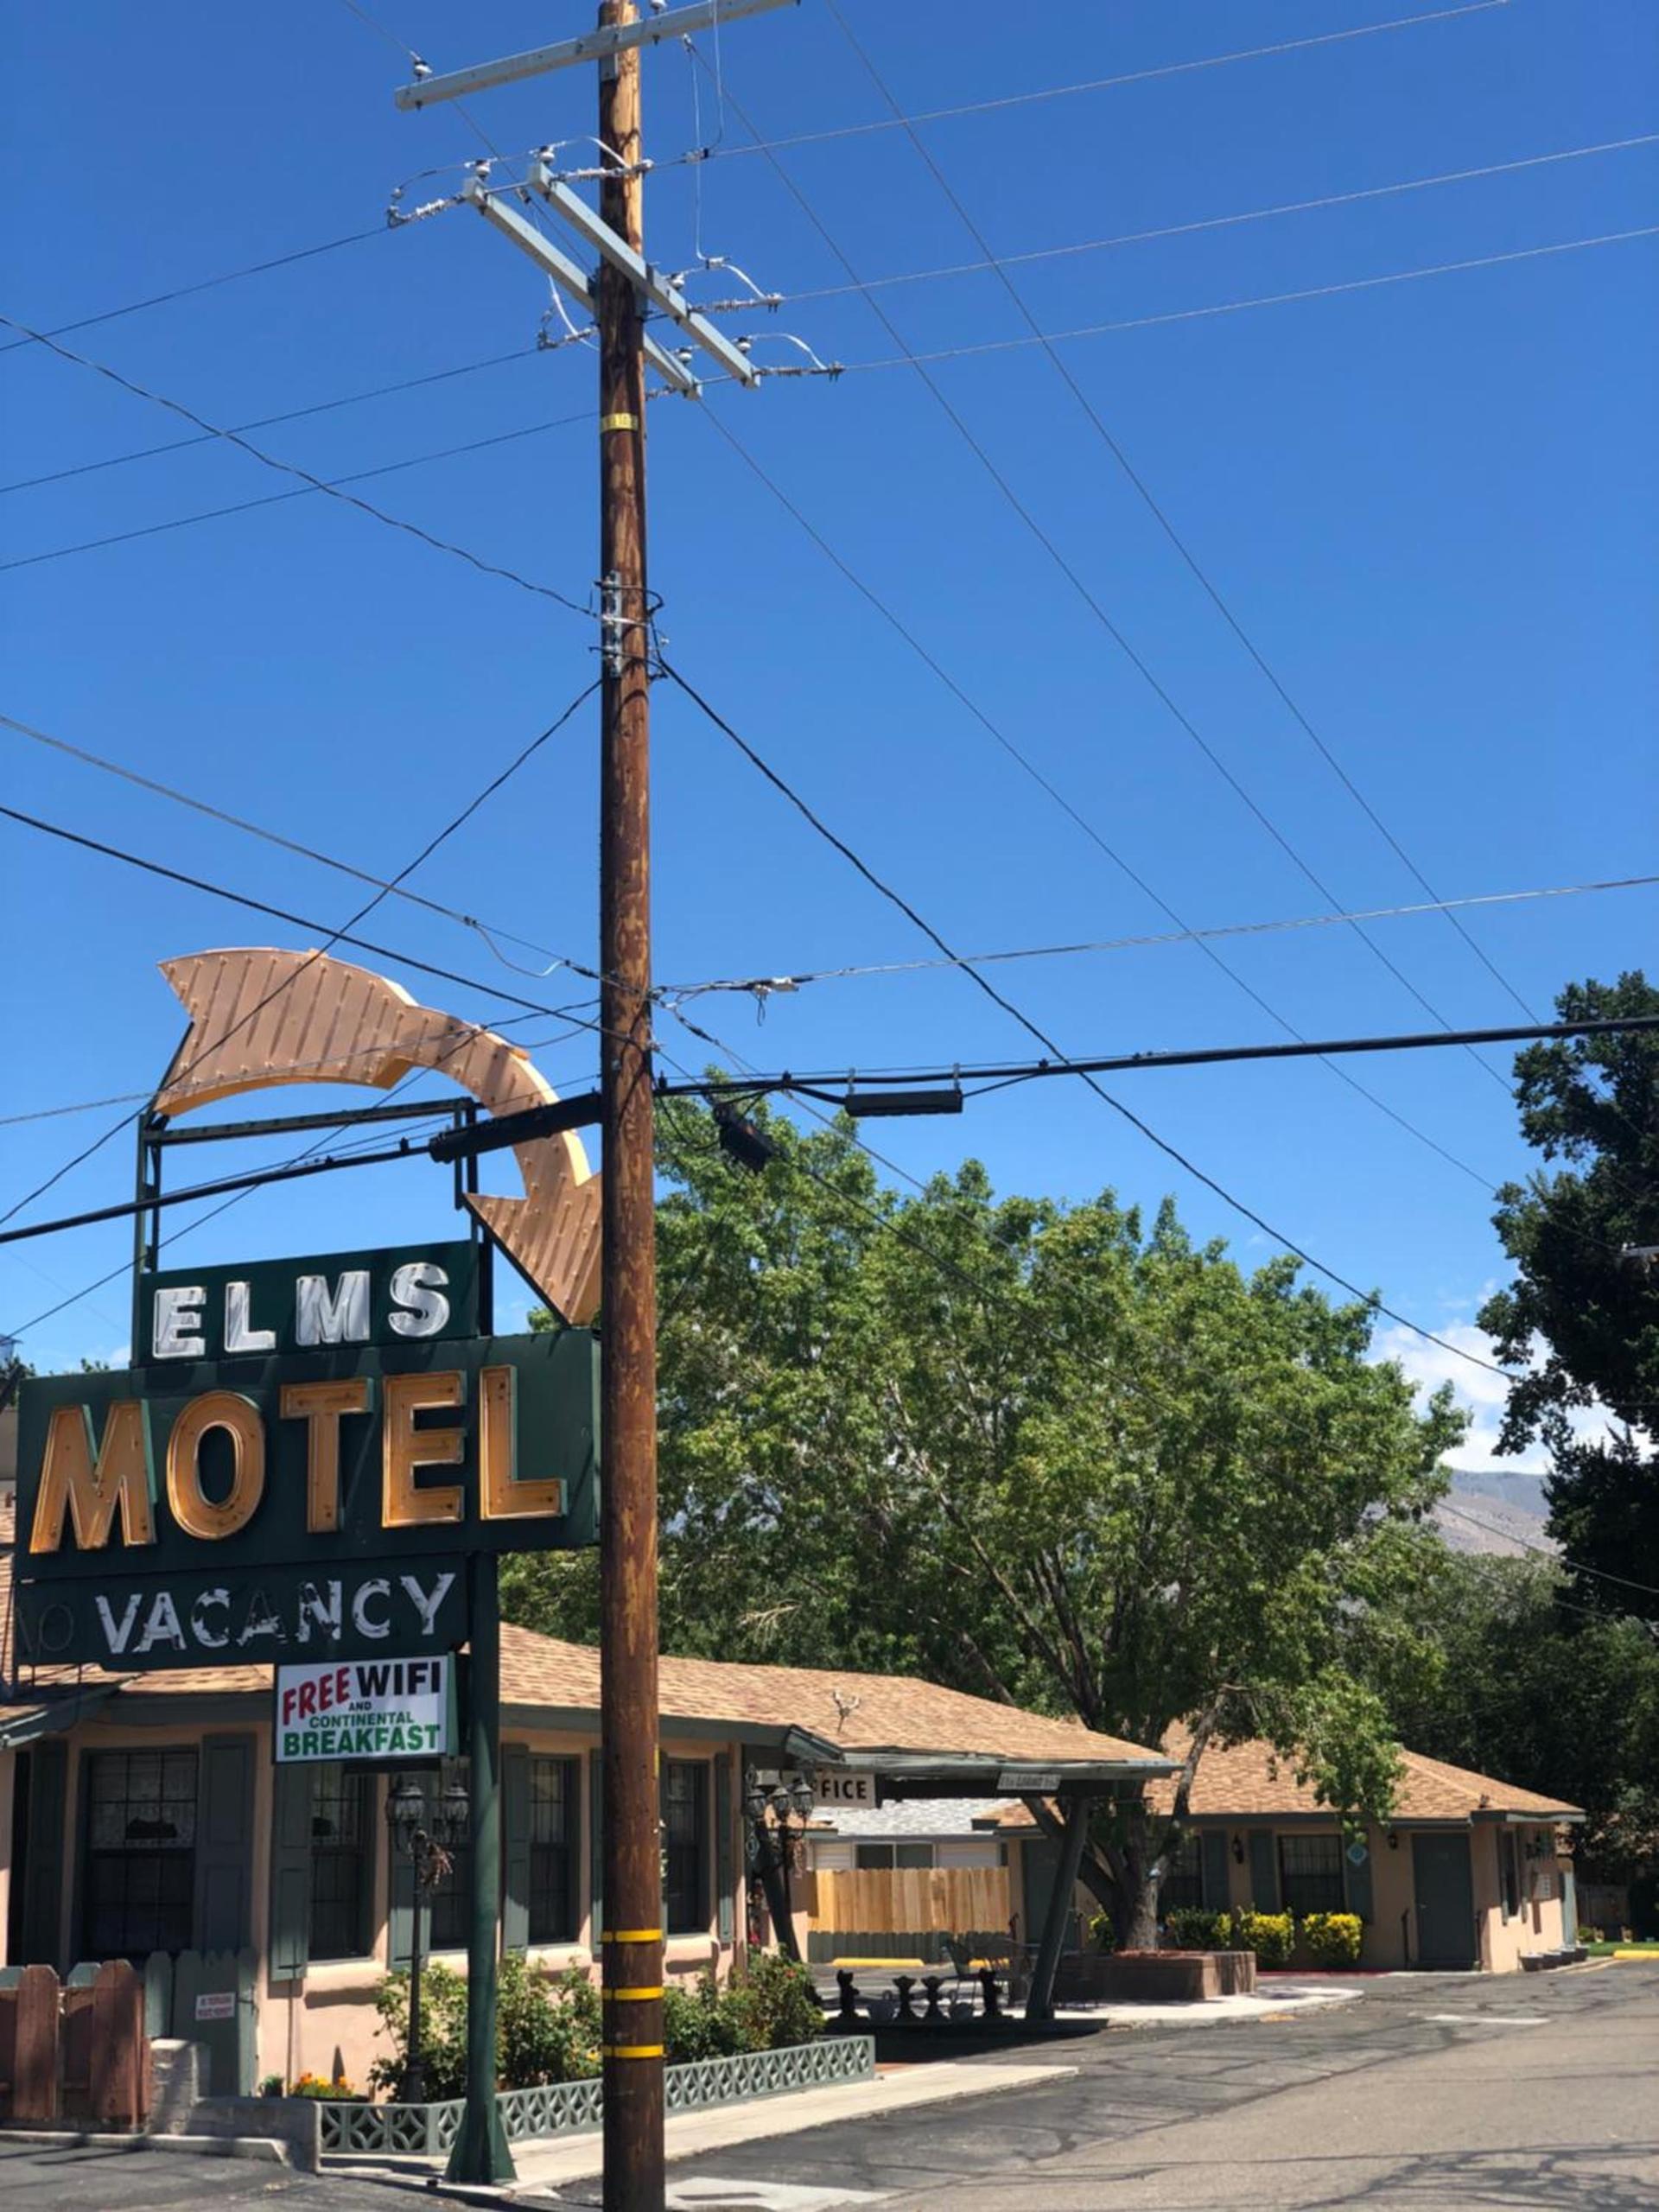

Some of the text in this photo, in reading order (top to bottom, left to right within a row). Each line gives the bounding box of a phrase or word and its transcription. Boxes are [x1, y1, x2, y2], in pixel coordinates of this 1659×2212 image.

[151, 1262, 450, 1360] ELMS
[29, 1363, 569, 1554] MOTEL
[94, 1572, 456, 1655] VACANCY
[283, 1662, 441, 1726] FREE WIFI
[348, 1700, 372, 1712] AND
[283, 1725, 441, 1757] BREAKFAST
[309, 1711, 414, 1729] CONTINENTAL
[809, 1779, 867, 1799] FICE
